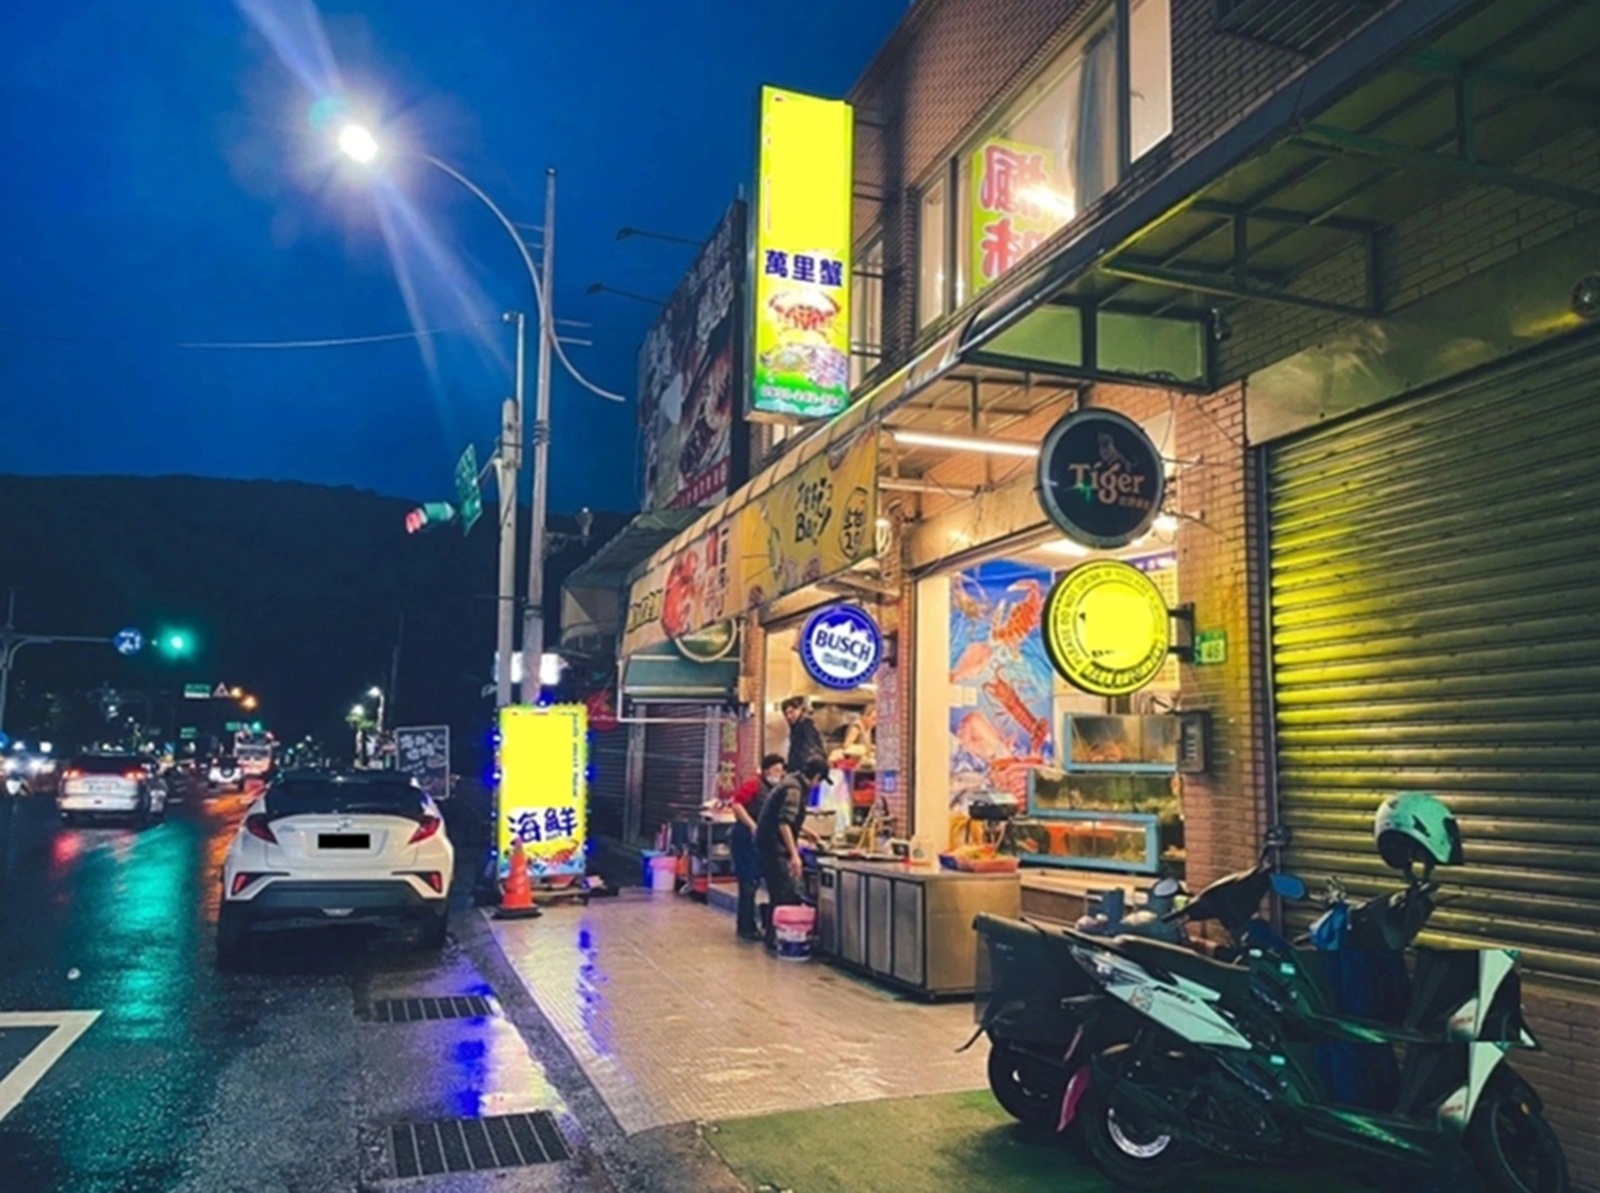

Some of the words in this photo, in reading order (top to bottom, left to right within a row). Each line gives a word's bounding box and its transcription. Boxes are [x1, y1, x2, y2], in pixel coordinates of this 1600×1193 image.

[765, 249, 842, 288] 萬里蟹
[1068, 461, 1145, 504] Tiger
[815, 629, 872, 662] BUSCH
[508, 807, 578, 846] 海鮮
